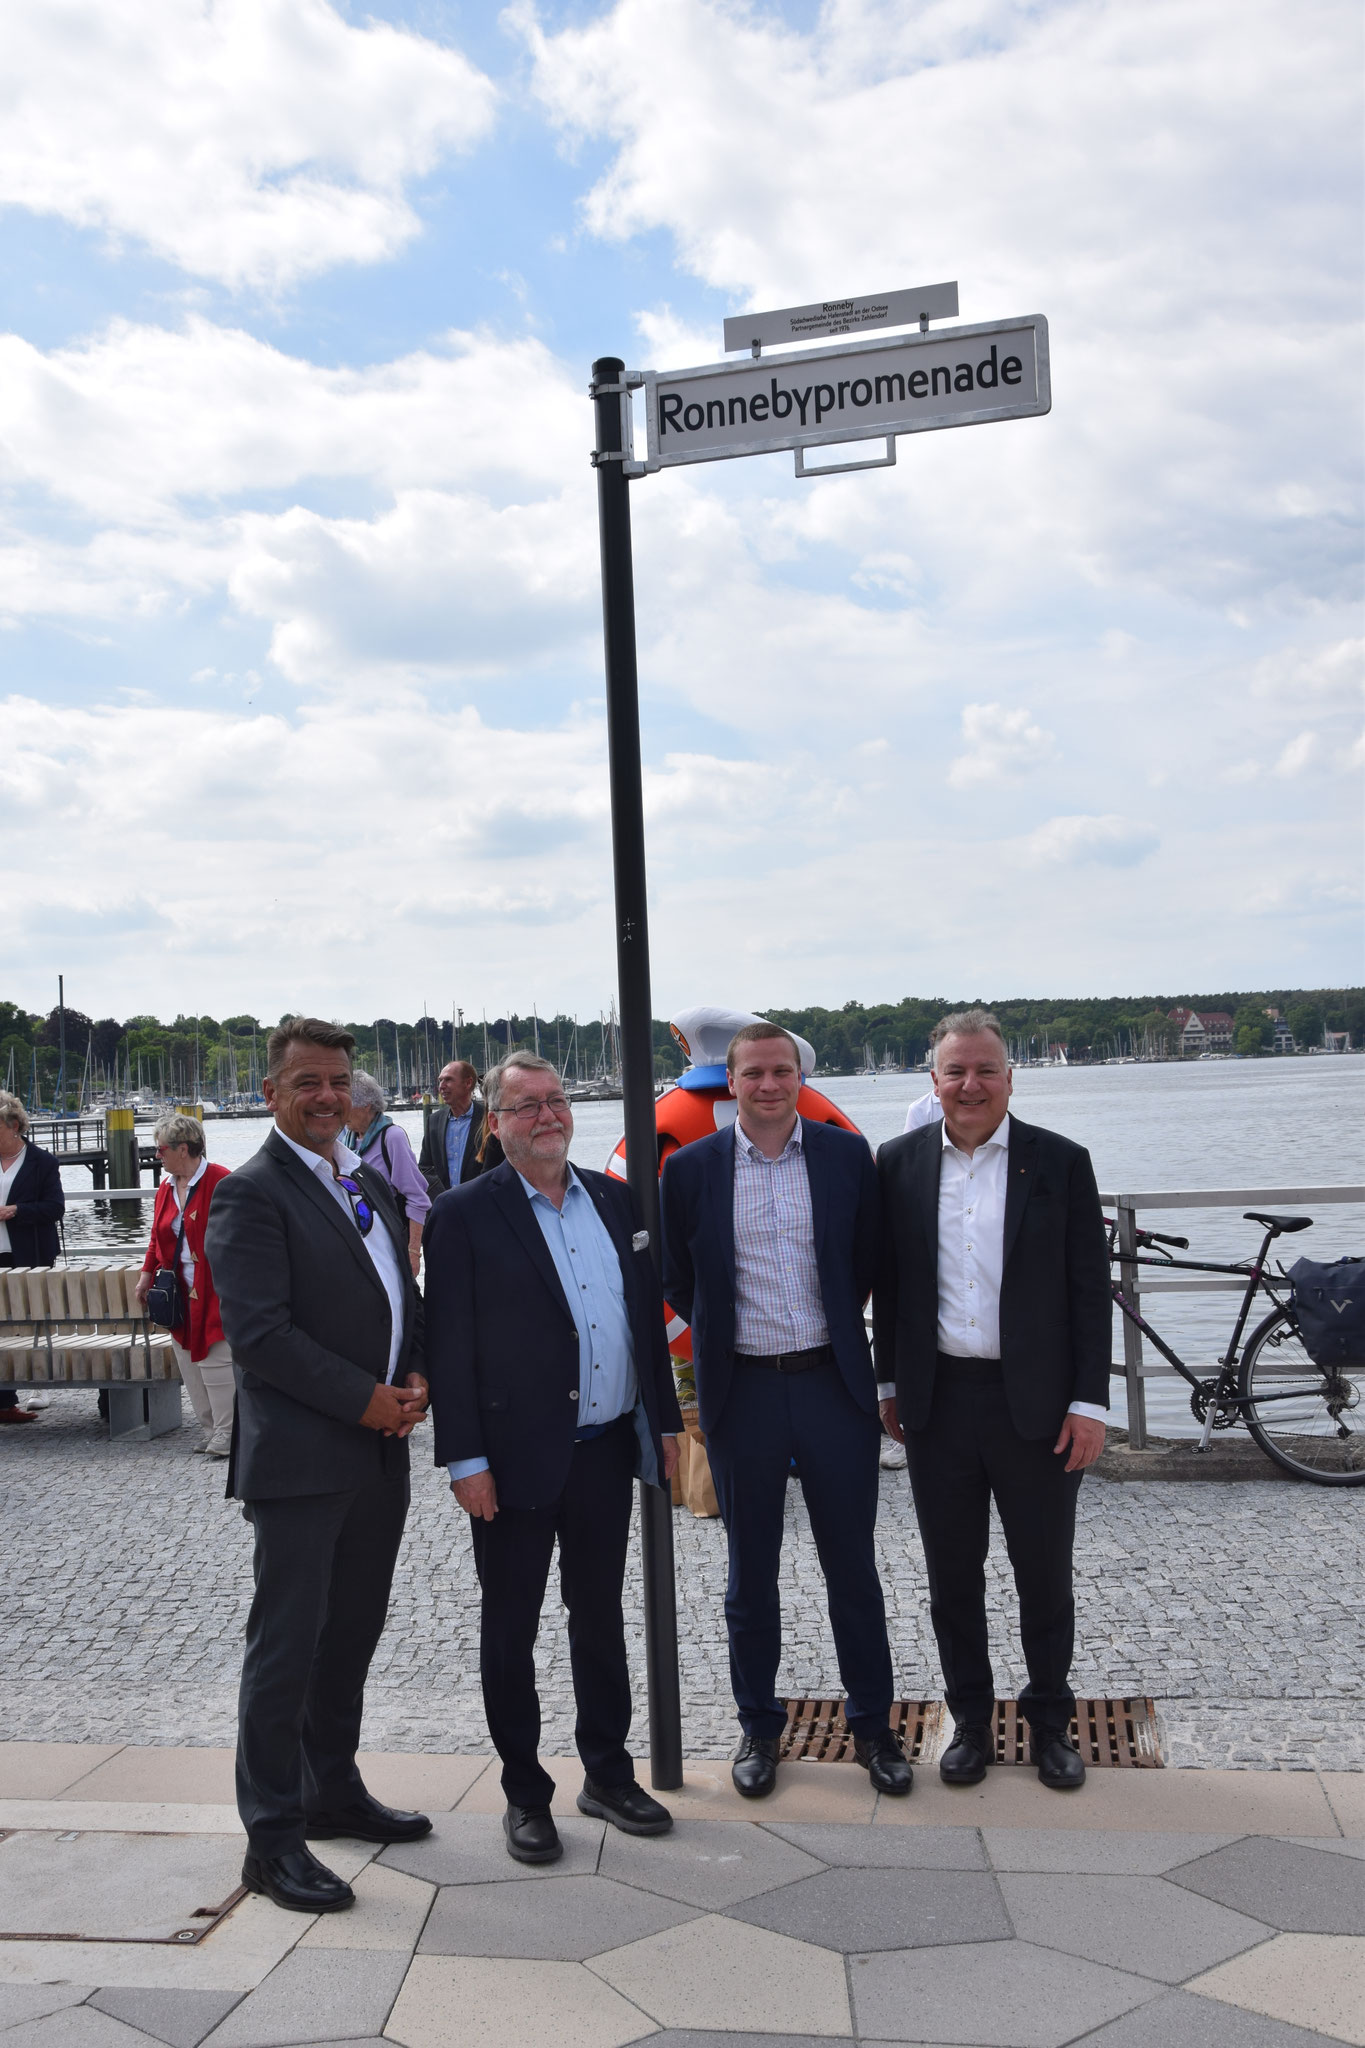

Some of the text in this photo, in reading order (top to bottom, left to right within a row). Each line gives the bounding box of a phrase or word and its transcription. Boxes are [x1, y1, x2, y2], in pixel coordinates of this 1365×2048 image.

[822, 300, 855, 313] Ronneby
[789, 315, 827, 325] Südschwedische
[827, 309, 854, 319] Hafenstadt
[791, 321, 832, 332] Partnergemeinde
[861, 311, 888, 321] Zehlendorf
[658, 344, 1023, 436] Ronnebypromenade
